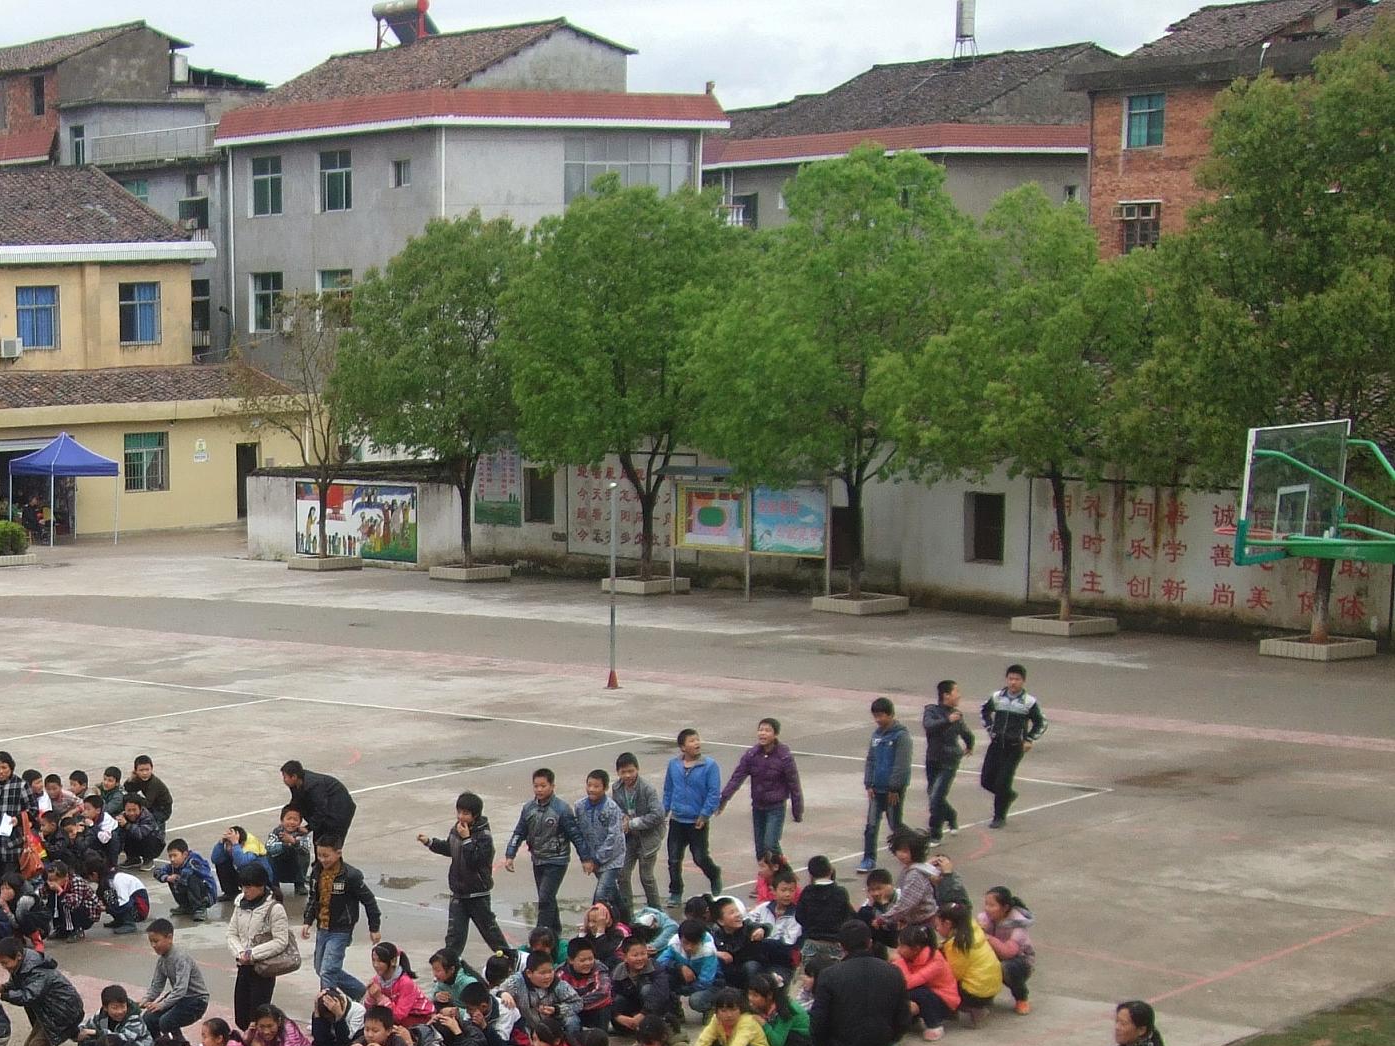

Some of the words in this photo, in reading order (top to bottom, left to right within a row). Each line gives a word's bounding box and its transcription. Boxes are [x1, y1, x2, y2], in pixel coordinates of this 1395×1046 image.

[1128, 497, 1190, 525] 向善
[1126, 537, 1188, 563] 乐学
[1049, 567, 1106, 595] 自主
[1126, 575, 1188, 603] 创新
[1210, 582, 1273, 612] 尚美
